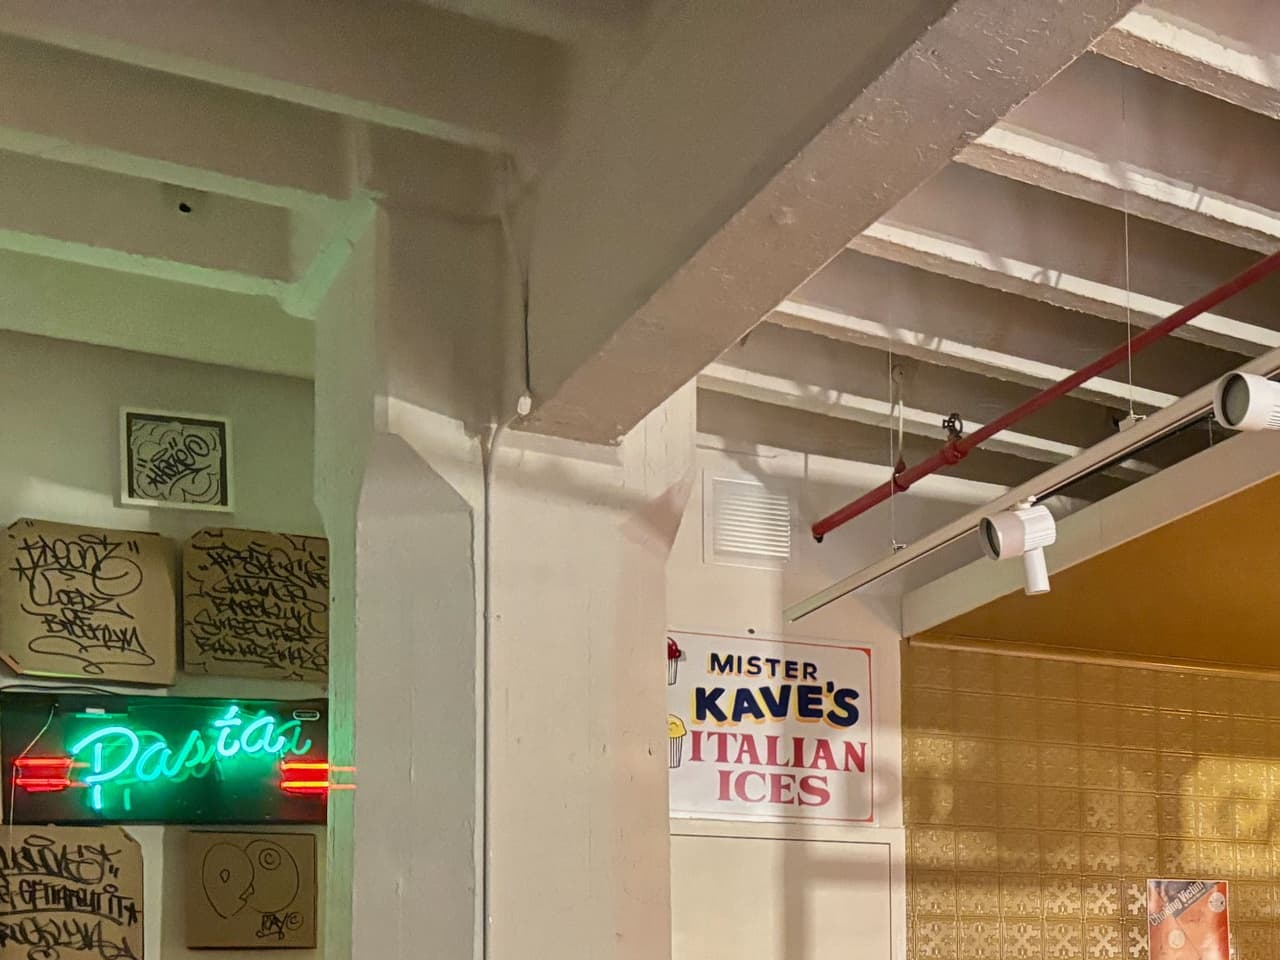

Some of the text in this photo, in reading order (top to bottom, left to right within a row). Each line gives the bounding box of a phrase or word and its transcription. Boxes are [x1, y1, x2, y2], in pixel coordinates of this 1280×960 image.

[708, 652, 818, 680] MISTER
[691, 681, 860, 729] KAVE'S
[72, 706, 286, 810] Pasta
[688, 729, 868, 773] ITALIAN
[717, 769, 832, 807] ICES
[1149, 899, 1183, 926] Choking
